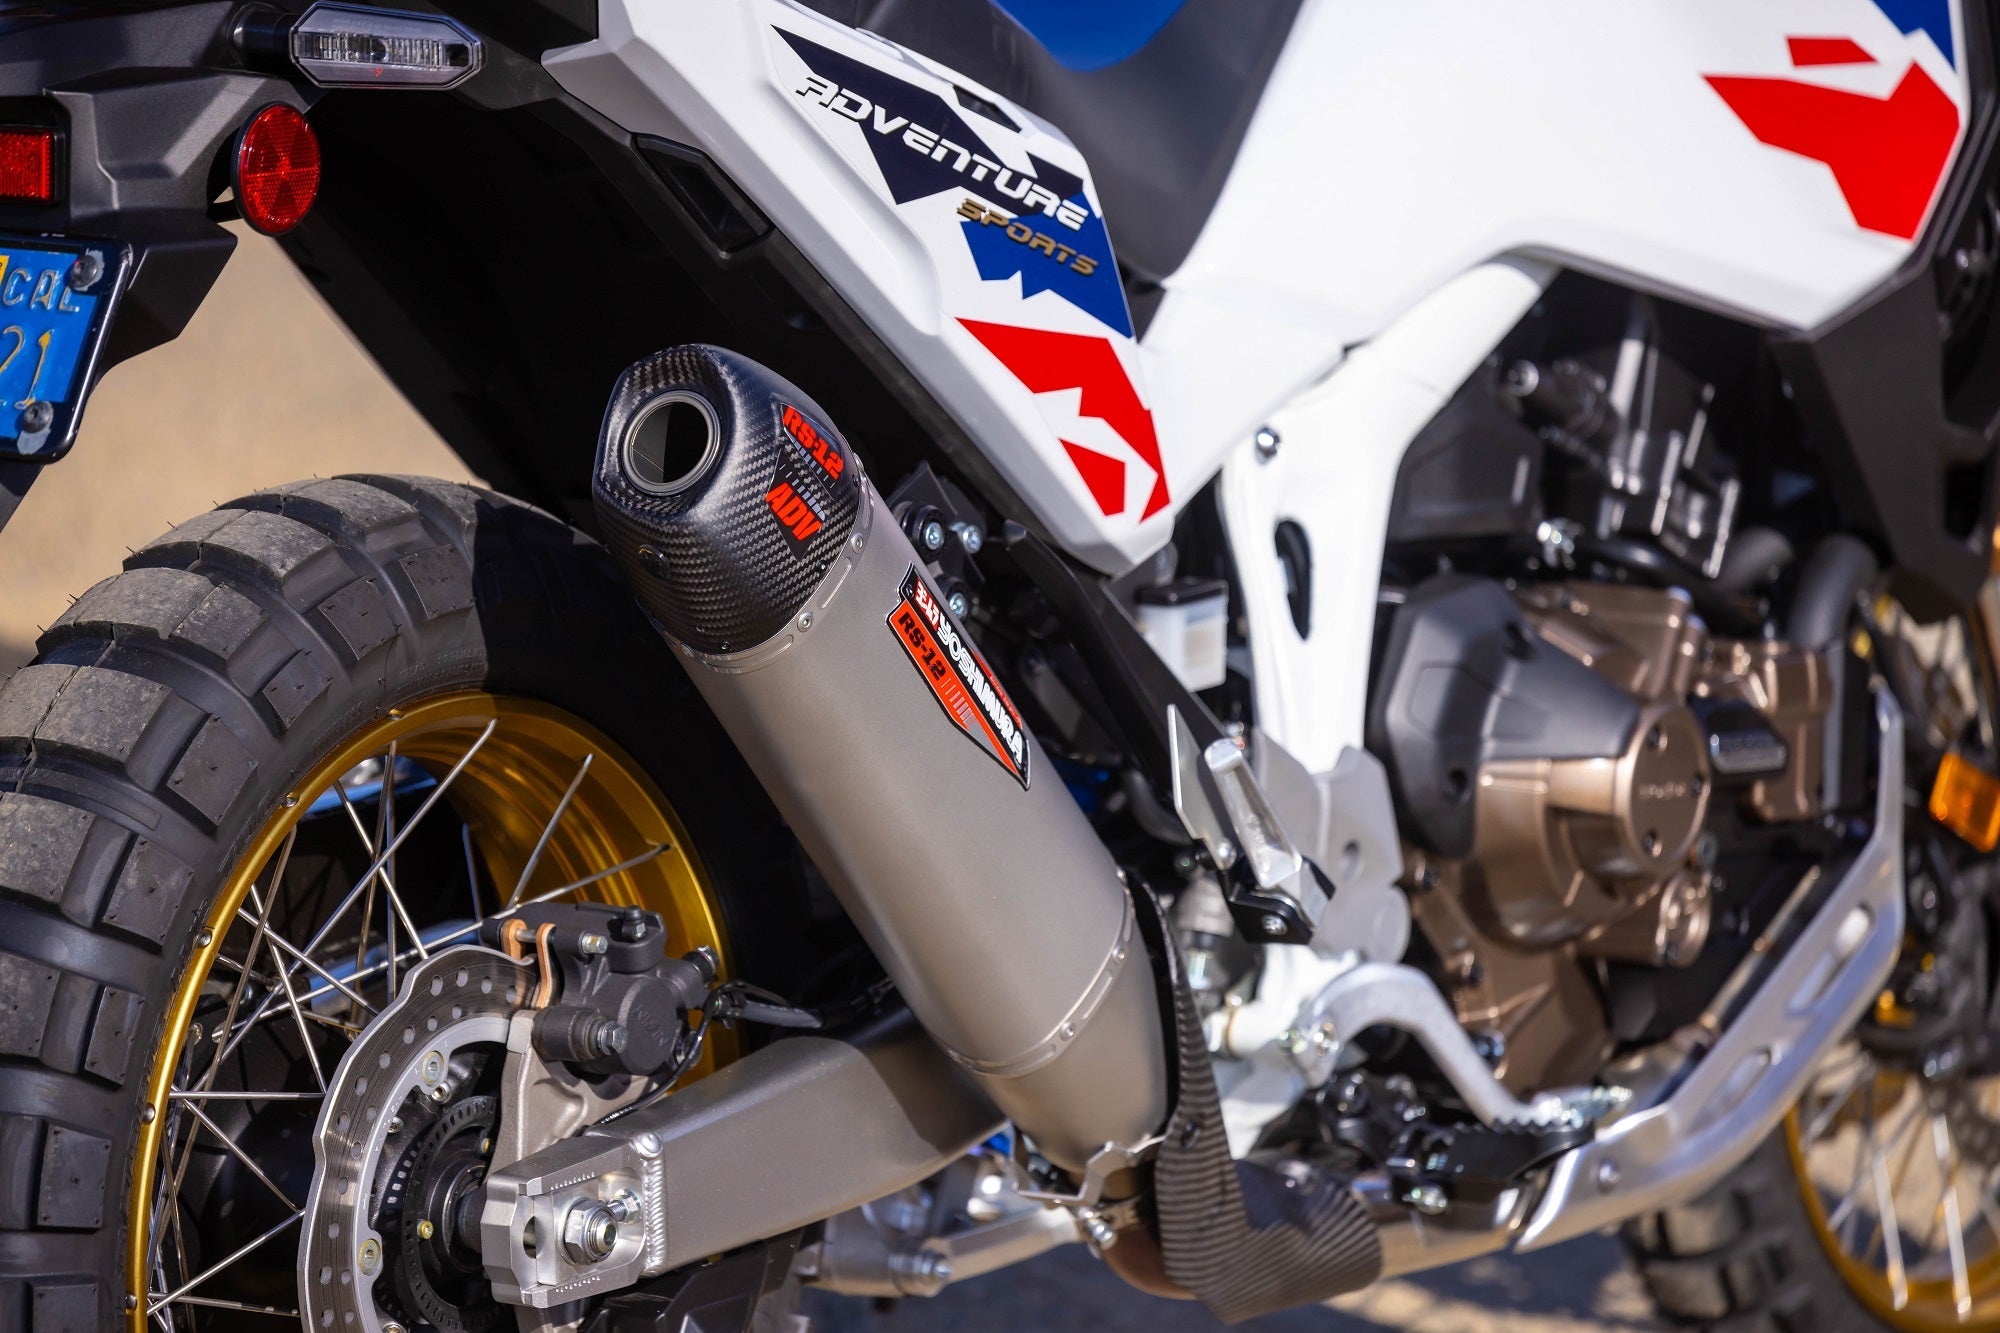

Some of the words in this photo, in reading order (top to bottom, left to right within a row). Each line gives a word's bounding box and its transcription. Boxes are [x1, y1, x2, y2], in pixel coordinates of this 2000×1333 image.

[796, 73, 1090, 231] ADVENTURE
[956, 198, 1098, 277] SPORTS
[766, 481, 822, 541] ADV
[898, 612, 946, 681] RS-12
[936, 613, 1024, 765] YOSHIMURA
